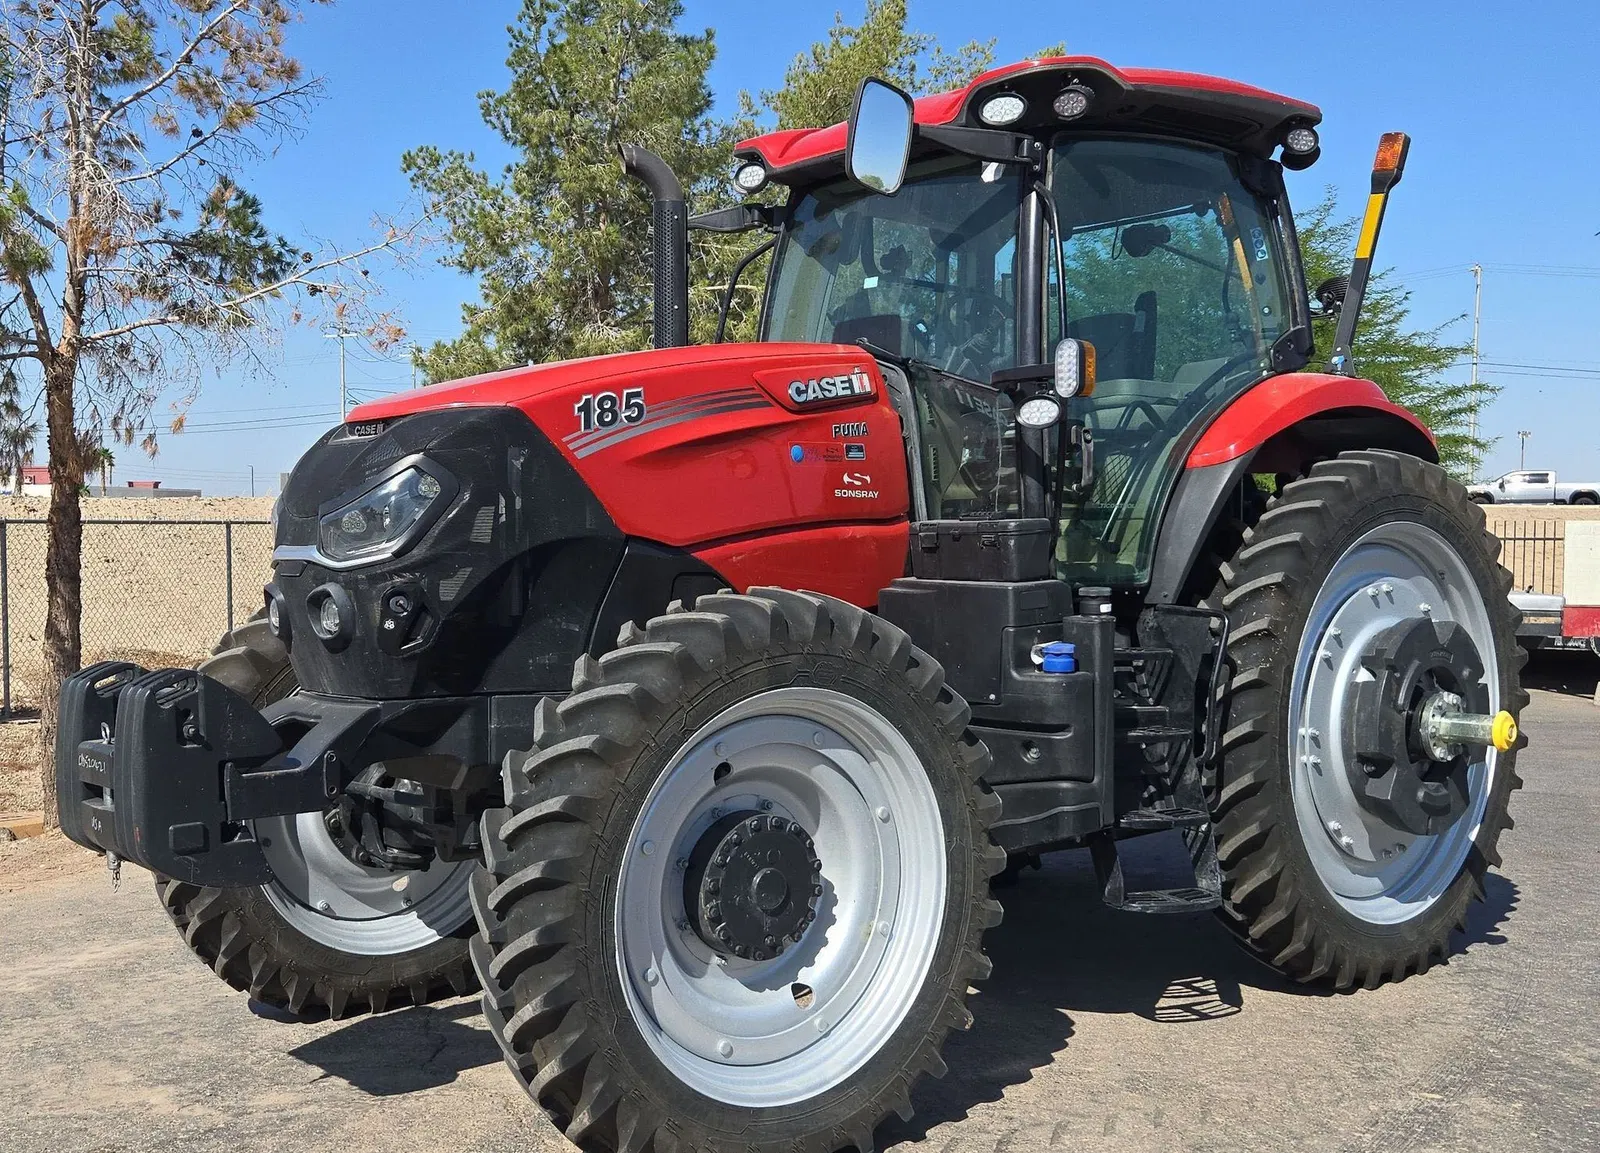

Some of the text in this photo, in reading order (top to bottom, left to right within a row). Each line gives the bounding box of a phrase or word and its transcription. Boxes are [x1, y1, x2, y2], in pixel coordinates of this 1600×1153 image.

[574, 387, 647, 433] 185
[832, 421, 869, 438] PUMA
[834, 489, 879, 499] SONSRAY
